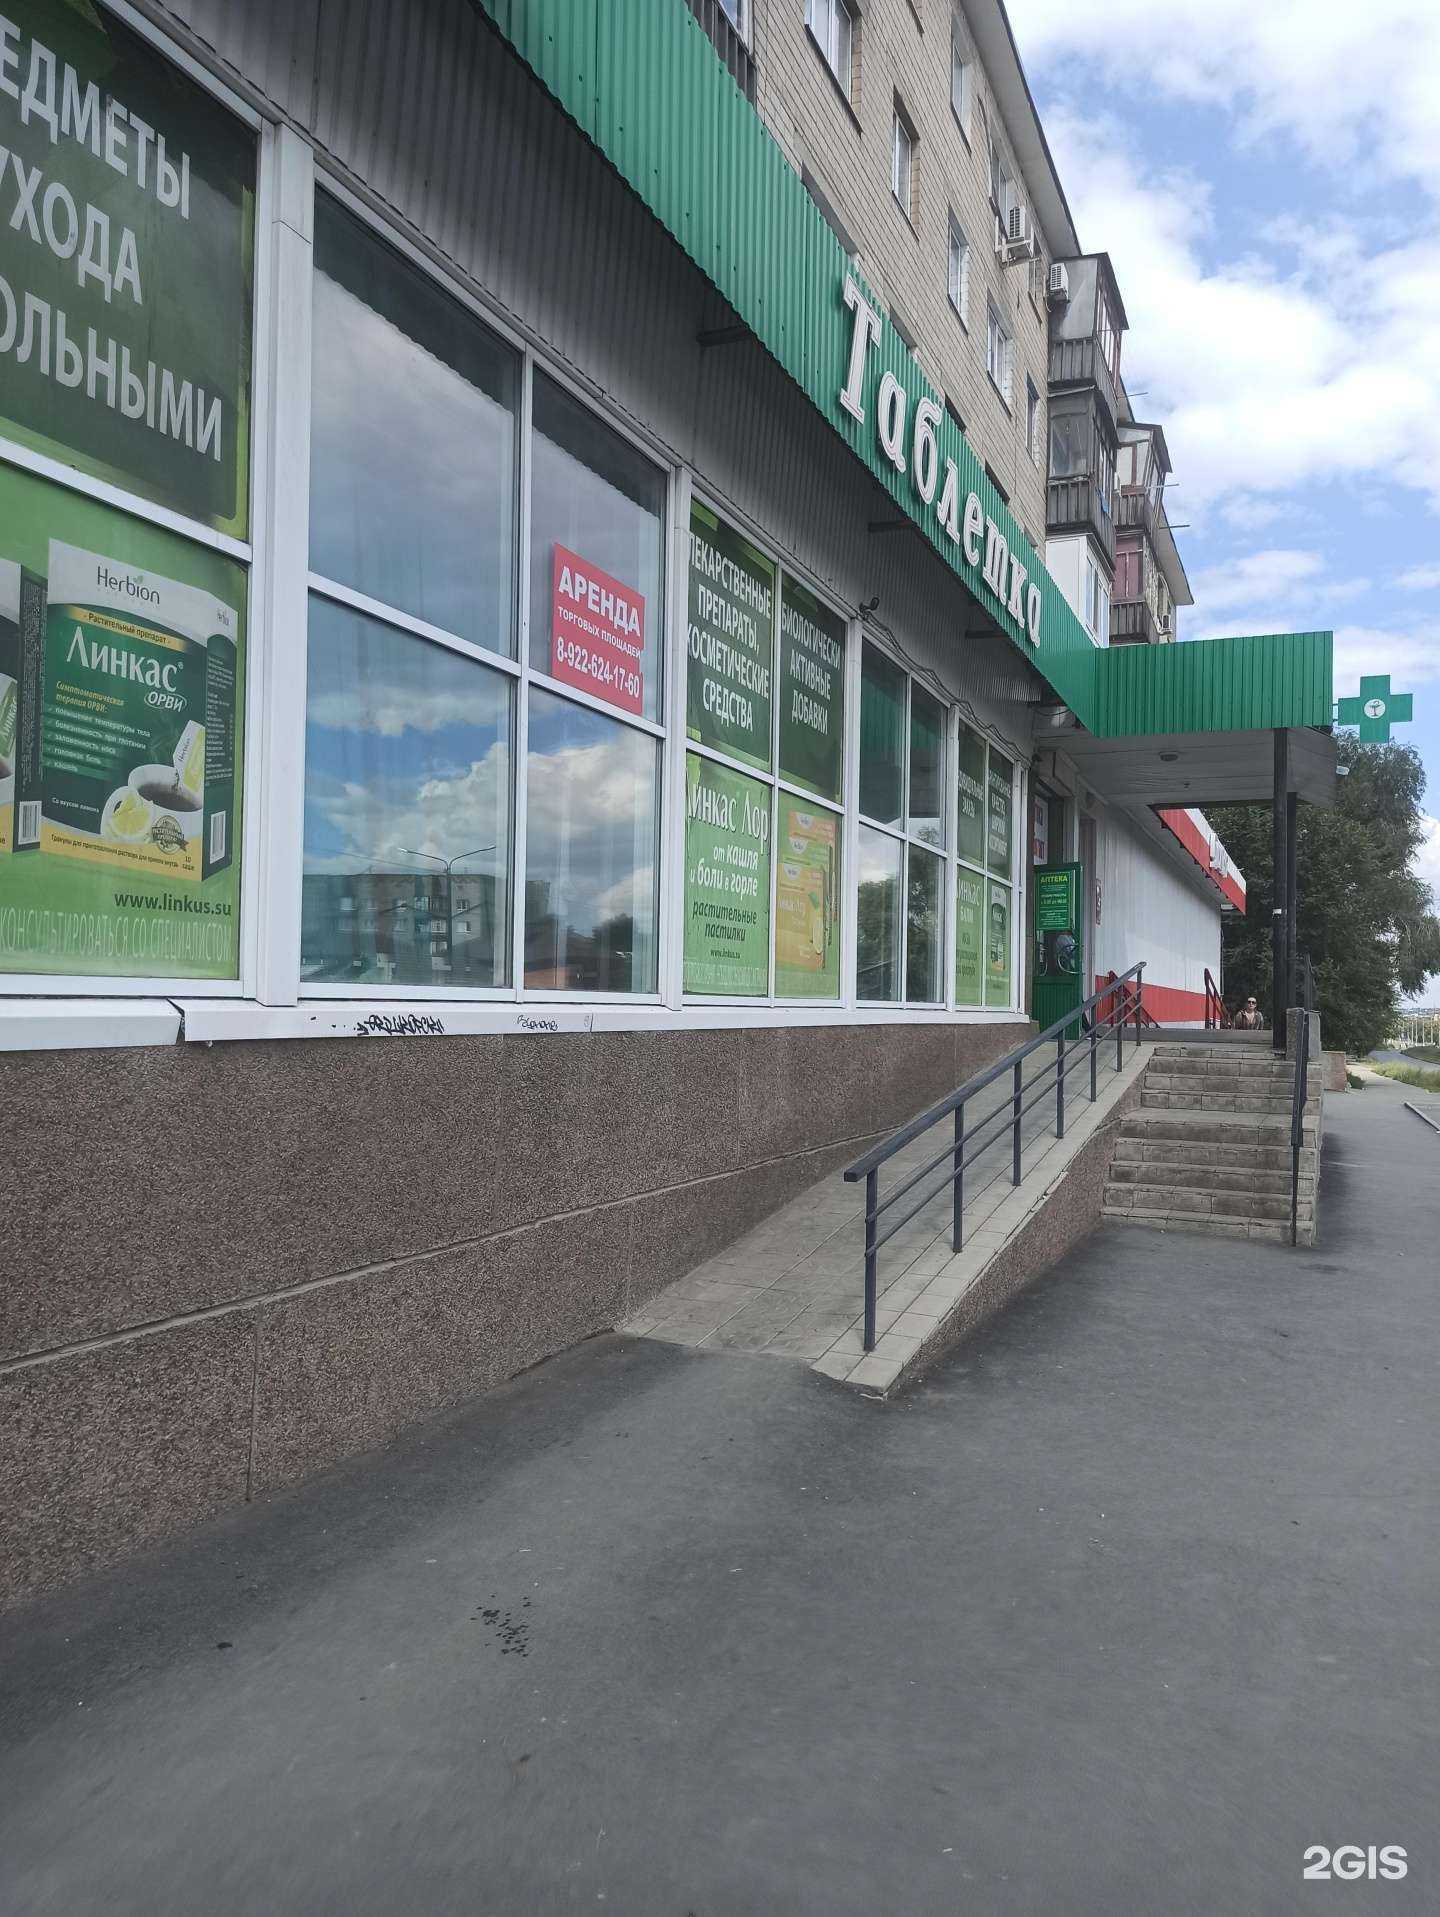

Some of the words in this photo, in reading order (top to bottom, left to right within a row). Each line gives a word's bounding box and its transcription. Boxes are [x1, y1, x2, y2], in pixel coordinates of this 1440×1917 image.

[840, 271, 1040, 648] Таблетка
[97, 565, 160, 604] Herbion
[558, 565, 641, 637] АРЕНДА
[136, 628, 167, 645] препарат
[698, 583, 760, 656] ПРЕПАРАТЫ,
[781, 601, 841, 671] БИОЛОГИЧЕСКИ
[66, 625, 177, 692] Линкас
[556, 636, 640, 699] 8-922-624-17-60
[789, 648, 831, 701] АКТИВНЫЕ
[148, 690, 184, 713] ОРВИ
[702, 678, 753, 732] СРЕДСТВА
[791, 688, 828, 736] ДОБАВКИ
[741, 790, 769, 856] Лор
[697, 858, 723, 890] боли
[730, 873, 758, 901] горле
[713, 846, 725, 862] от
[726, 844, 759, 871] кашля
[114, 892, 232, 916] www.linkus.su
[692, 900, 758, 925] растительные
[704, 922, 746, 942] пастилки
